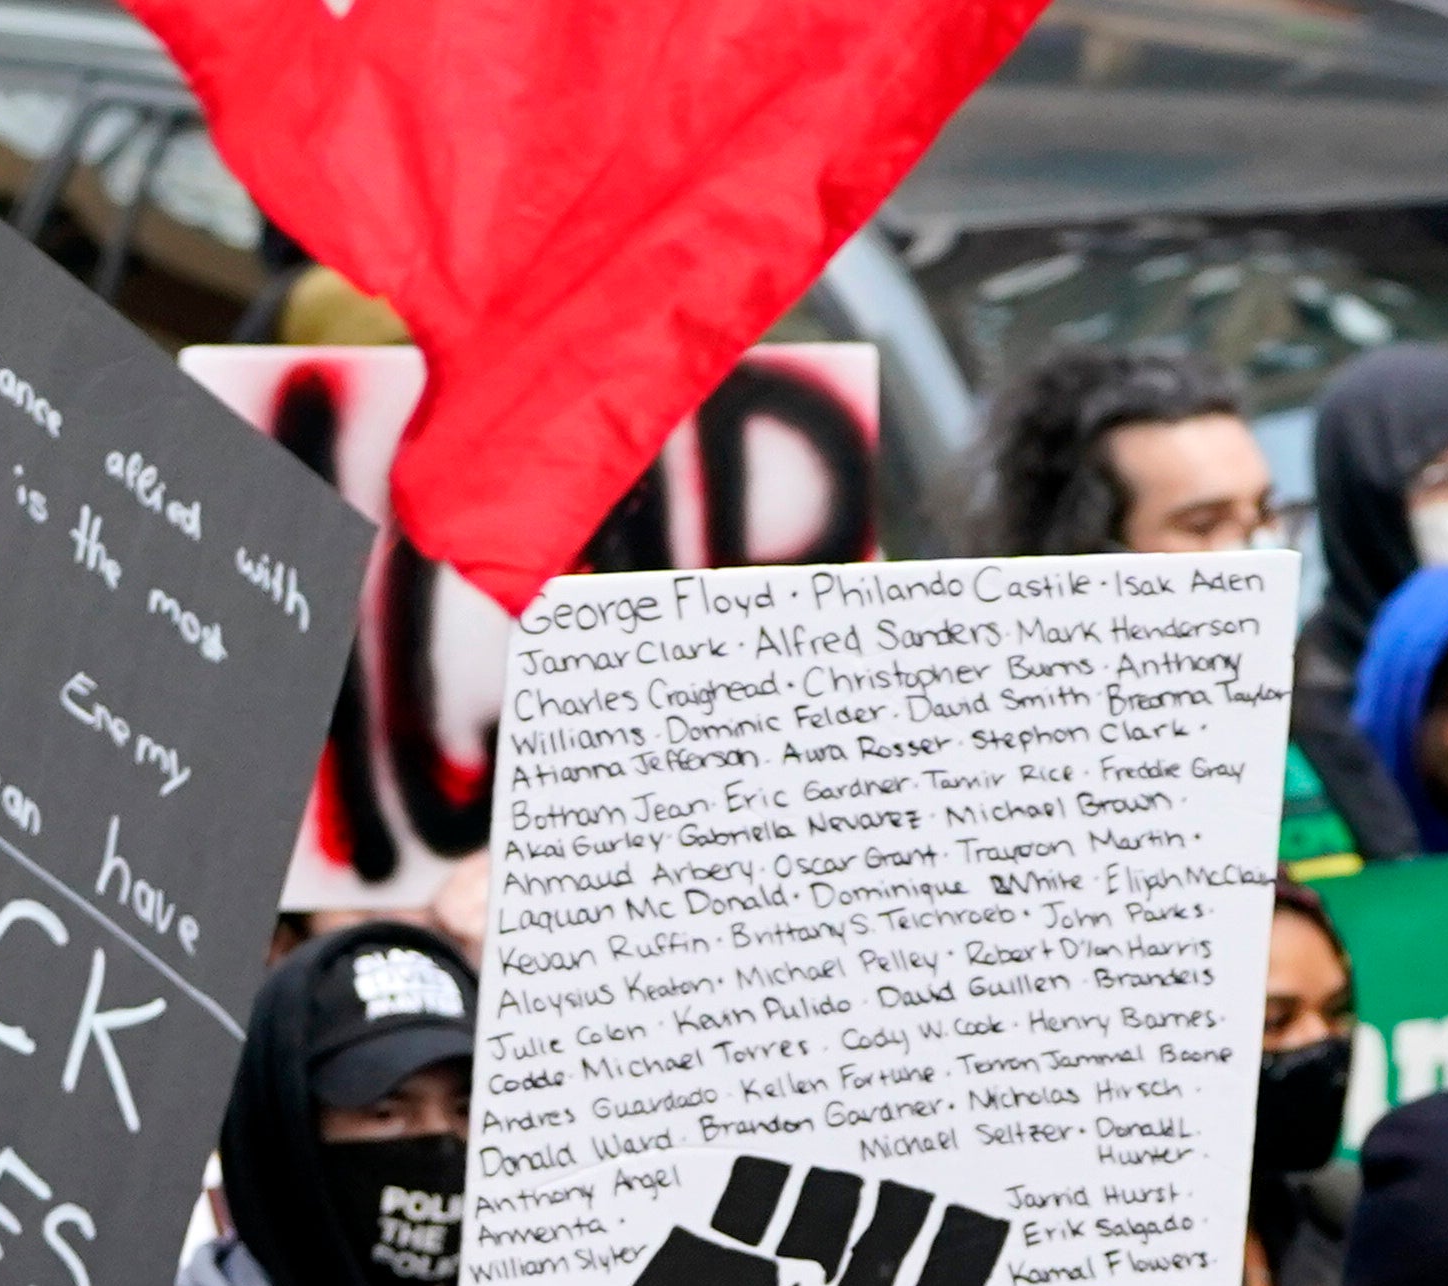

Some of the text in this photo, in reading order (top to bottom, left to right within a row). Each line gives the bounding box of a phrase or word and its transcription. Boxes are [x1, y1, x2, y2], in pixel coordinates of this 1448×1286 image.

[12, 464, 47, 526] is
[70, 505, 123, 591] the
[104, 450, 201, 541] allied
[235, 546, 311, 631] with
[518, 566, 1264, 635] George Floyd Philando Castile Isak Aden
[518, 616, 1259, 675] Jamar Clark Alfred Sanders Mark Henderson
[59, 670, 192, 797] Enemy
[515, 652, 1242, 722] Charles Craighead Christopher Anthony
[96, 814, 201, 957] have
[378, 1216, 448, 1253] THE
